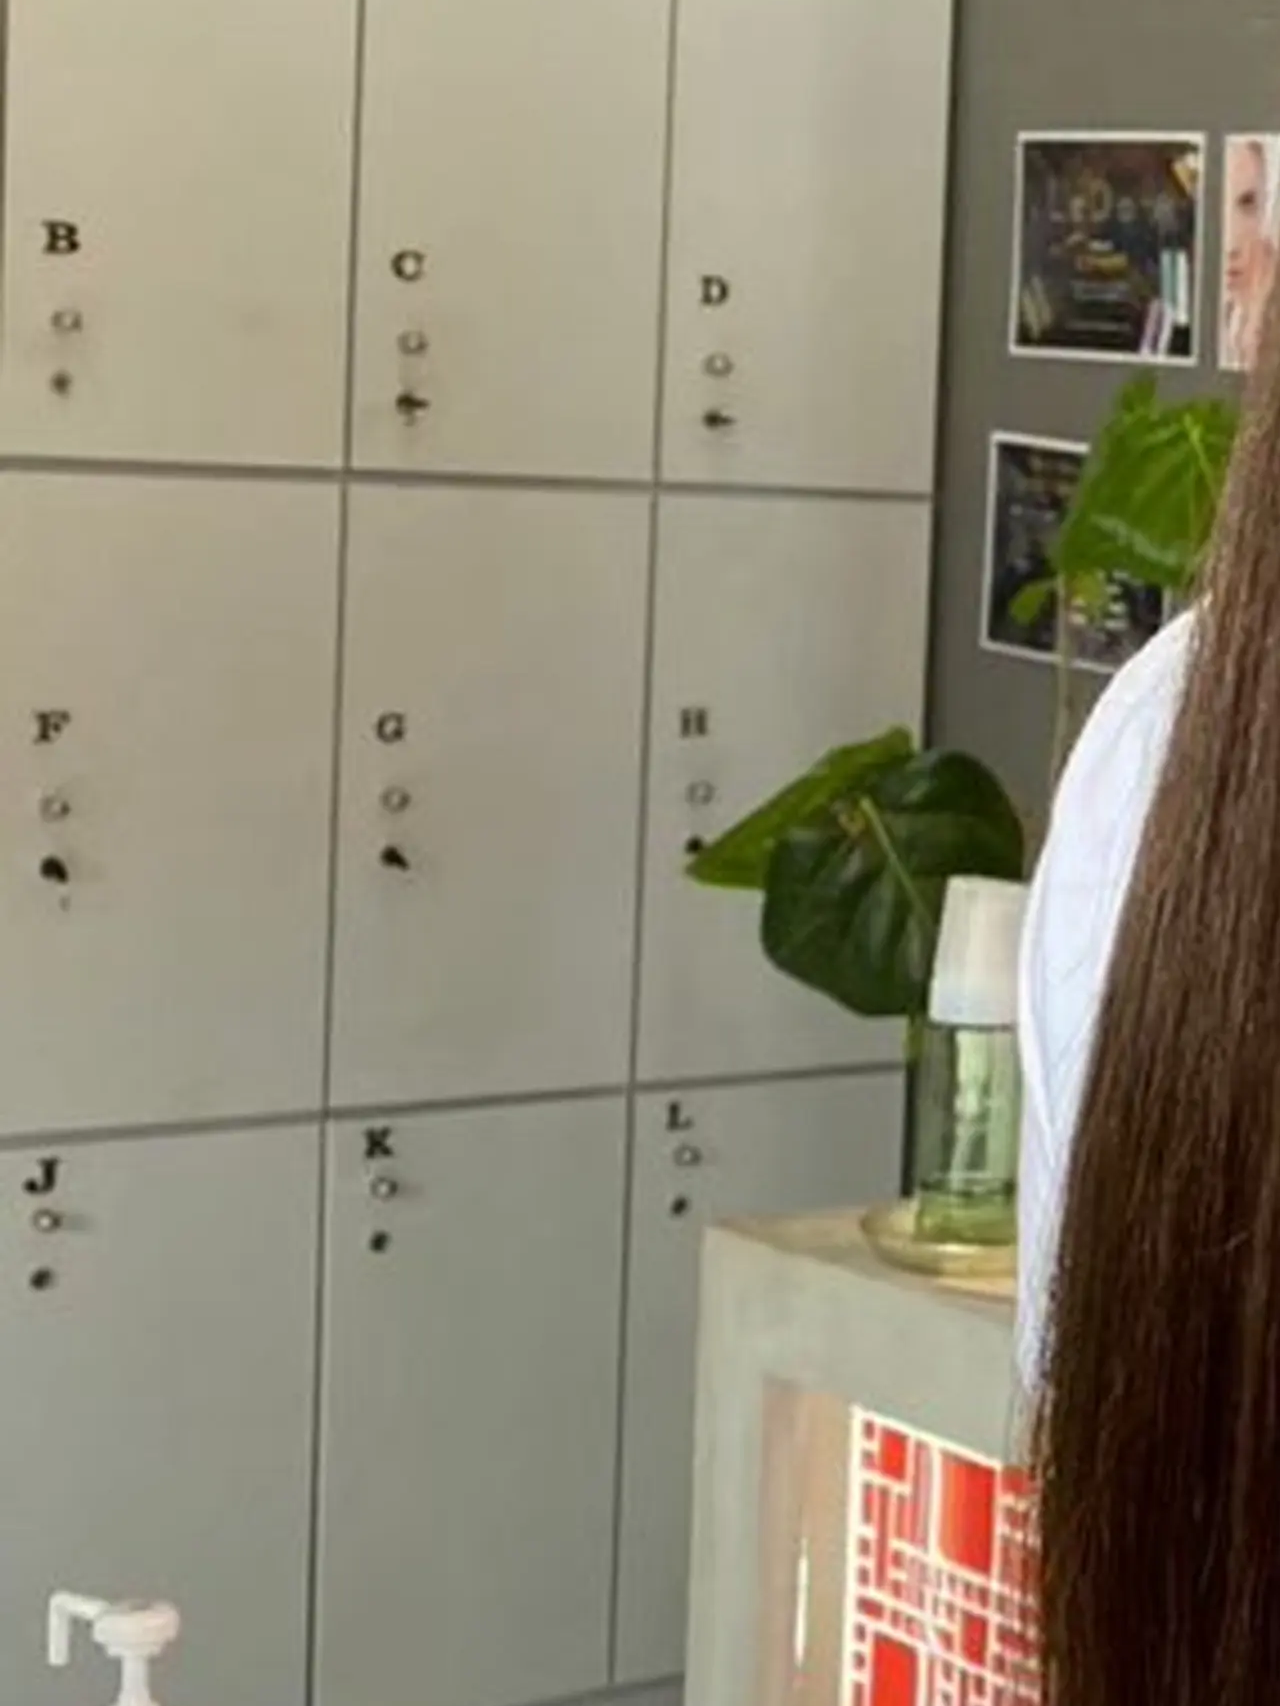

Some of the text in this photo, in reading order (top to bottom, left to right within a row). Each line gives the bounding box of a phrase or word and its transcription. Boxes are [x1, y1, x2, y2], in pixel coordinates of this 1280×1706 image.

[42, 219, 81, 256] B
[390, 249, 426, 282] C
[700, 274, 730, 306] D
[33, 709, 72, 746] F
[375, 711, 406, 745] G
[680, 706, 708, 739] H
[665, 1101, 694, 1133] L
[364, 1125, 394, 1160] K
[22, 1156, 61, 1195] J
